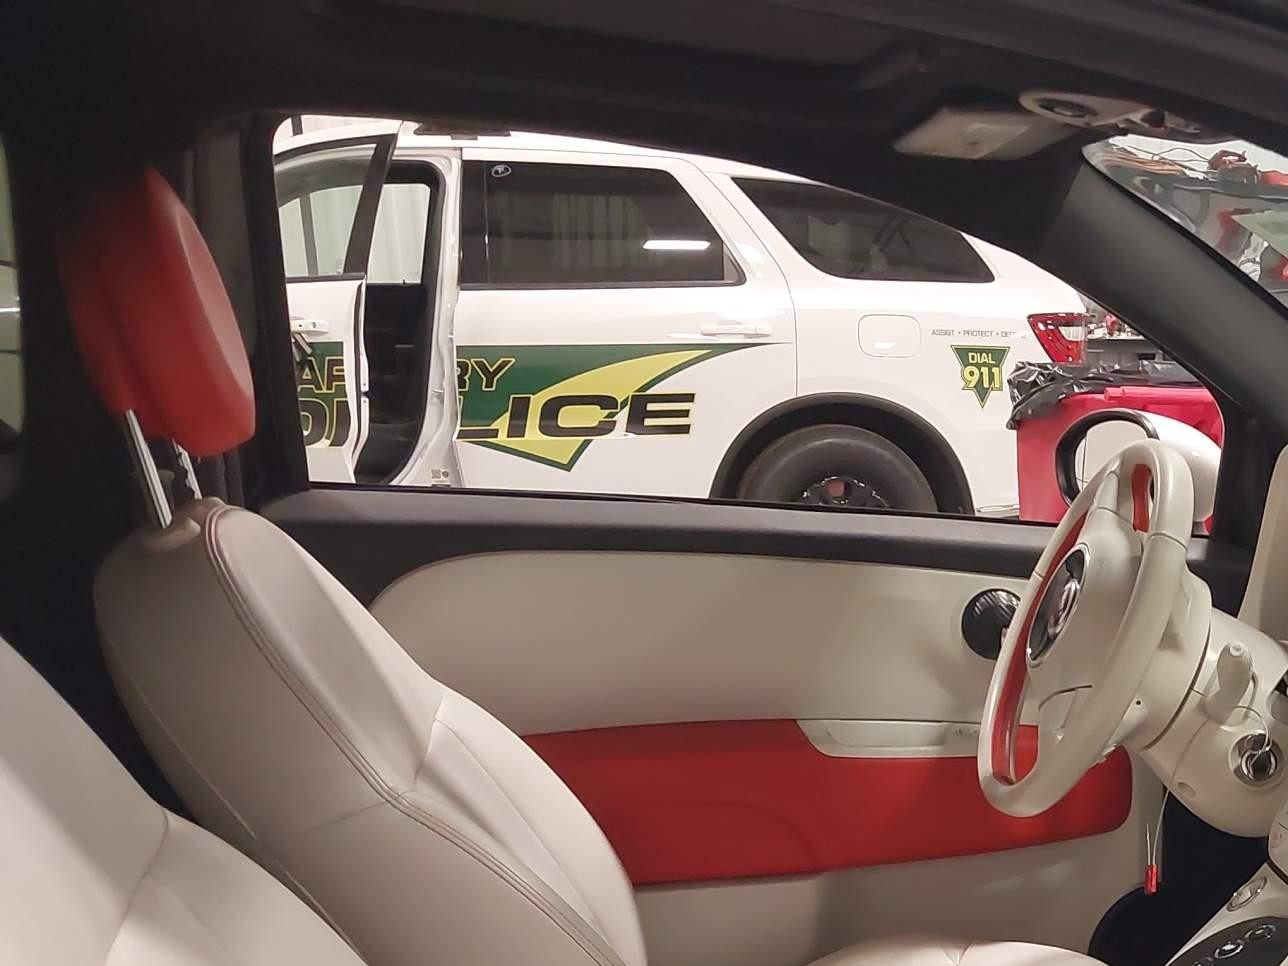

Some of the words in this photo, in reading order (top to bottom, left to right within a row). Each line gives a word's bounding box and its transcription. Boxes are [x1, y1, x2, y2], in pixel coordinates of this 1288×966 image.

[962, 330, 994, 338] PROTECT
[968, 352, 996, 364] DIAL
[963, 365, 1001, 389] 911
